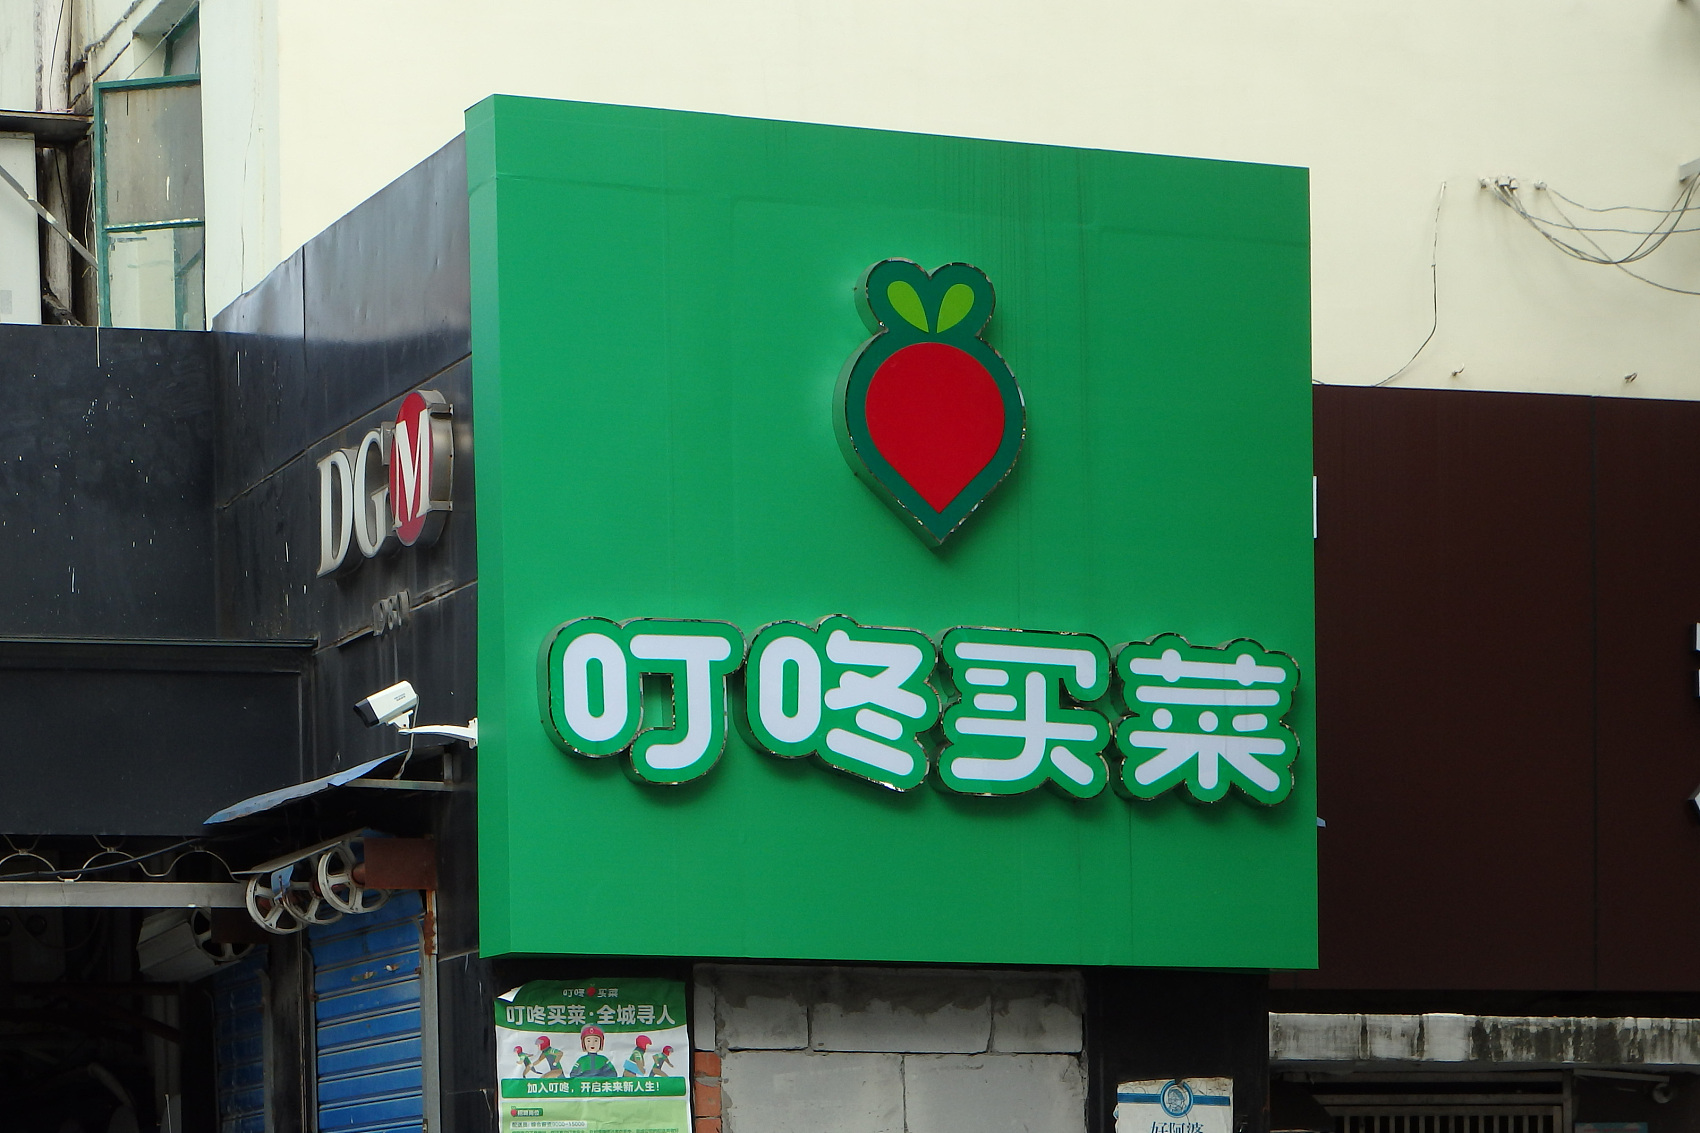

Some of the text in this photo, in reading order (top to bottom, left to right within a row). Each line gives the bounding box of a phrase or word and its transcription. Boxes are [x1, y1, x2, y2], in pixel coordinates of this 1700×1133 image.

[316, 406, 432, 578] DGM
[563, 629, 1286, 792] 叮咚买菜
[506, 1004, 676, 1026] 叮咚买菜·全城寻人
[562, 988, 619, 998] 叮咚 买菜
